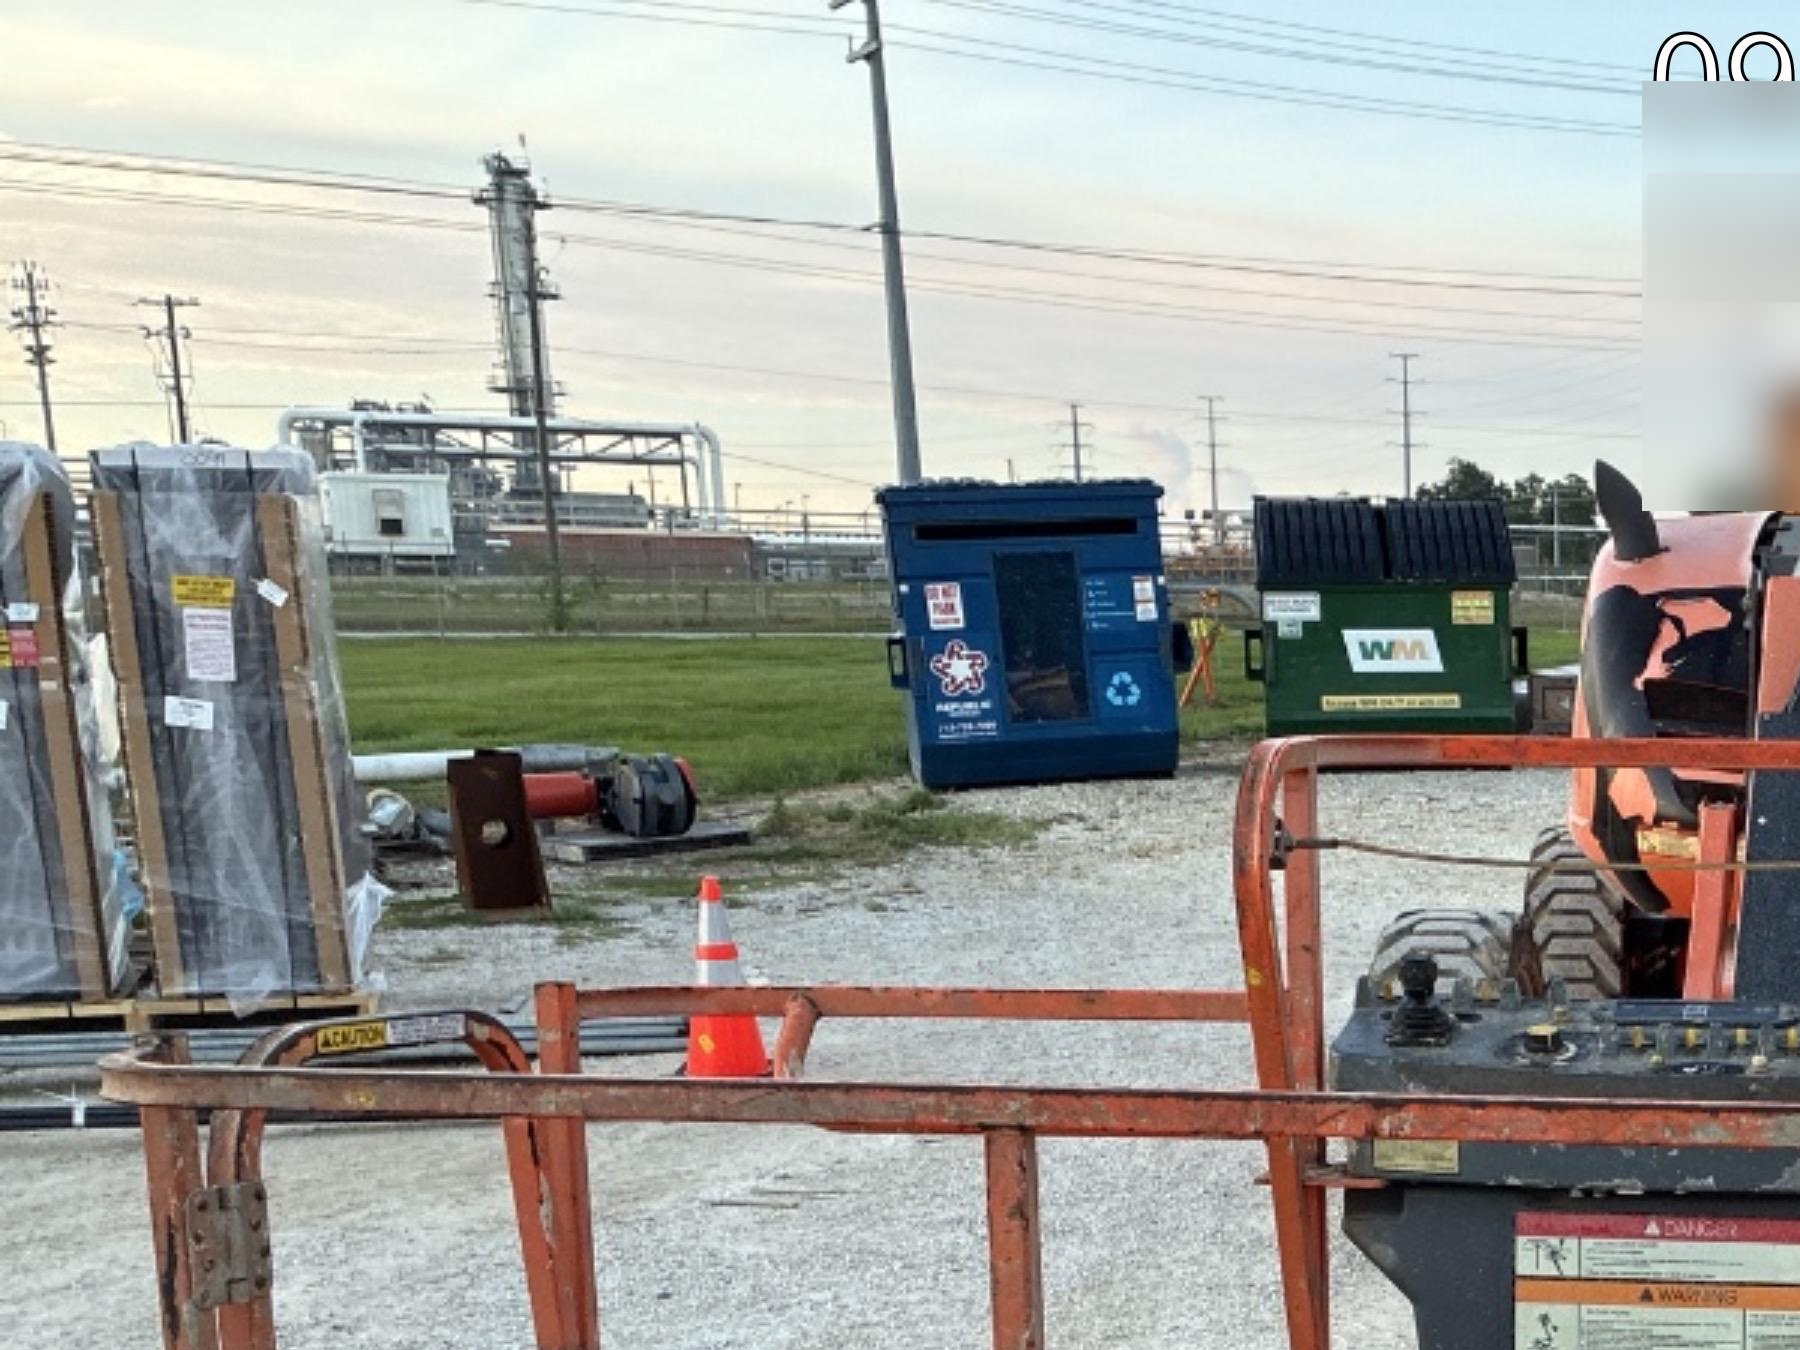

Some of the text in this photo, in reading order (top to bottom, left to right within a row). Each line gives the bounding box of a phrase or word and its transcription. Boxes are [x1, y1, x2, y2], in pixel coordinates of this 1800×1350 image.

[1358, 640, 1431, 661] WM
[331, 1025, 384, 1048] CAUTION
[1663, 1220, 1739, 1238] DANGER
[1656, 1289, 1738, 1305] WARNING
